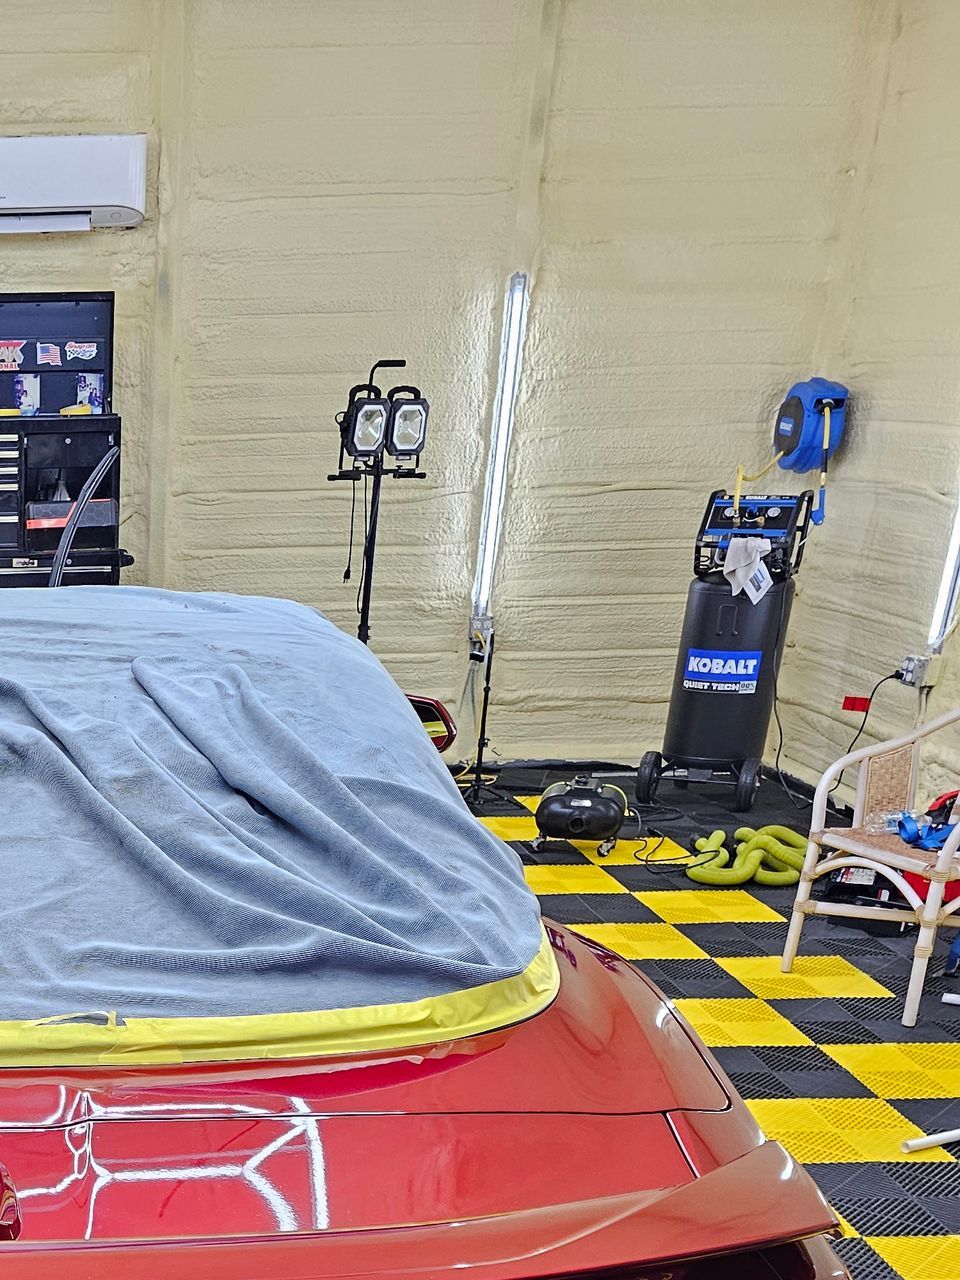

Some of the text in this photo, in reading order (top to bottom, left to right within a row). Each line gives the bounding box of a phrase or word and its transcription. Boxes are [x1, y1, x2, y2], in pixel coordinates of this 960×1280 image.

[687, 656, 758, 675] KOBALT
[683, 680, 710, 690] QUIET
[711, 682, 740, 691] TECH
